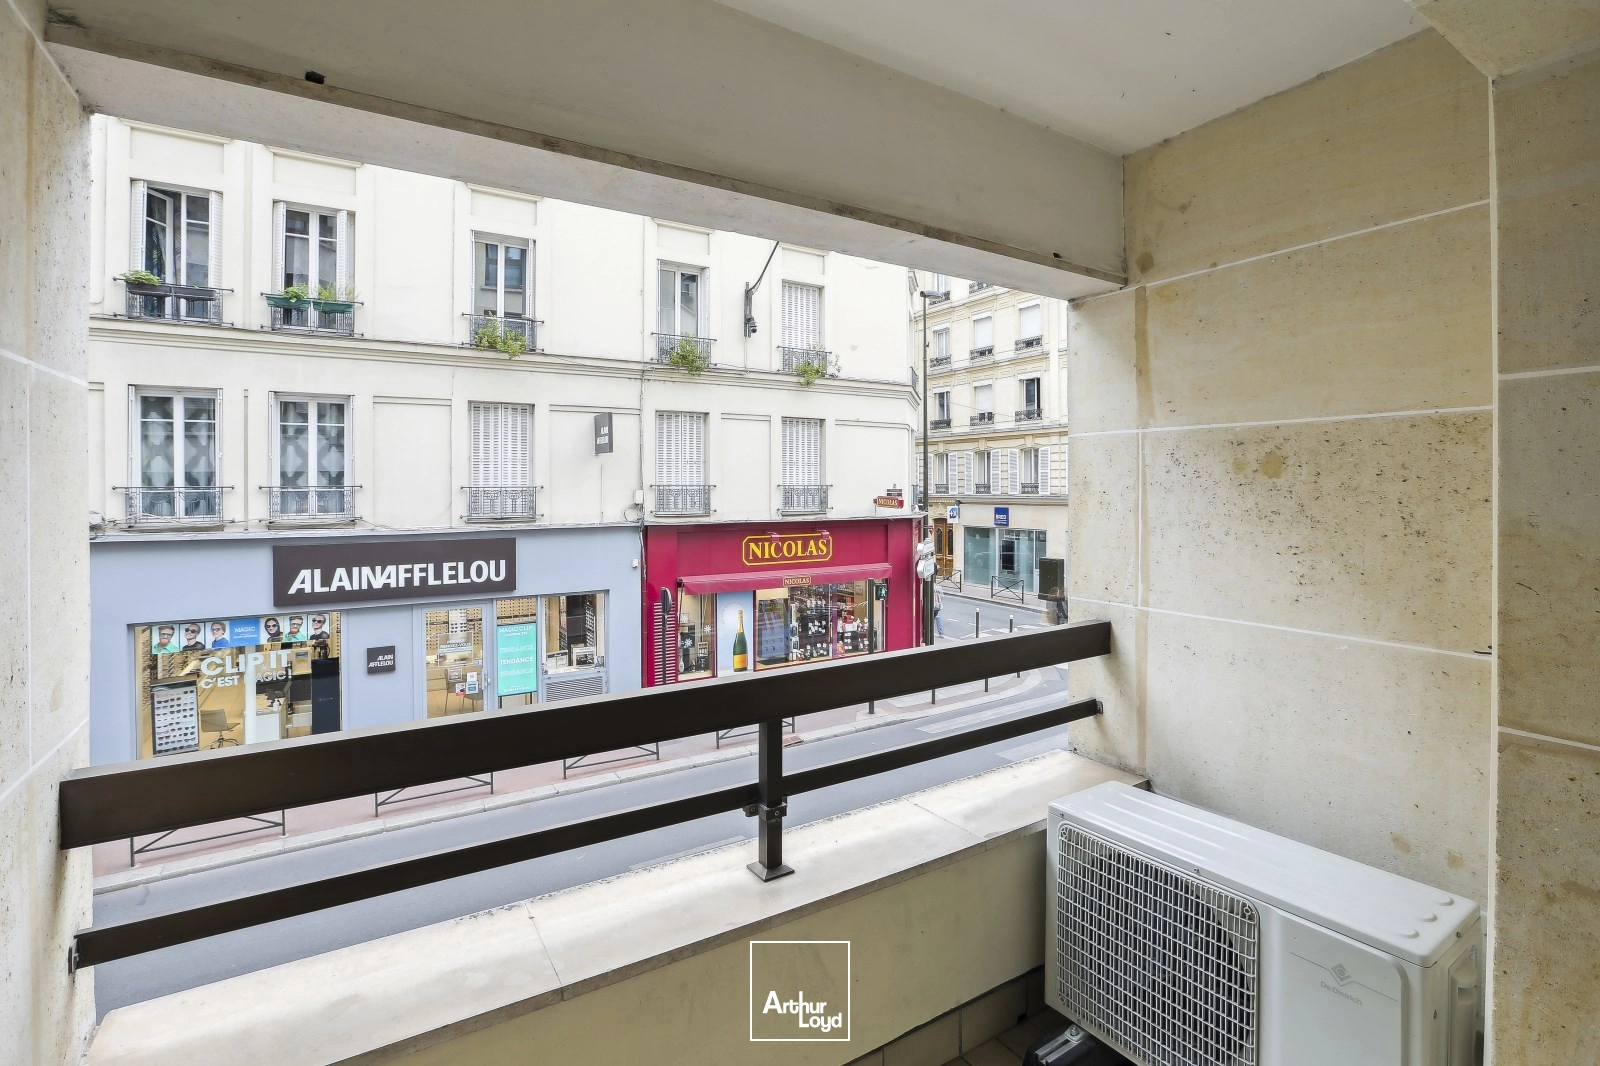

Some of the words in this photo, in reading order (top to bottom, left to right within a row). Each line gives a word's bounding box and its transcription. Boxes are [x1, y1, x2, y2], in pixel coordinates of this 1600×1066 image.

[877, 498, 898, 506] NICOLAS
[748, 539, 827, 560] NICOLAS
[784, 577, 810, 585] NICOLAS
[201, 652, 264, 676] CLIP
[270, 650, 292, 668] IT
[368, 660, 394, 668] AFFLELOU
[500, 656, 534, 665] TENDANCE
[200, 674, 240, 690] C'EST
[244, 668, 292, 684] AGIC!
